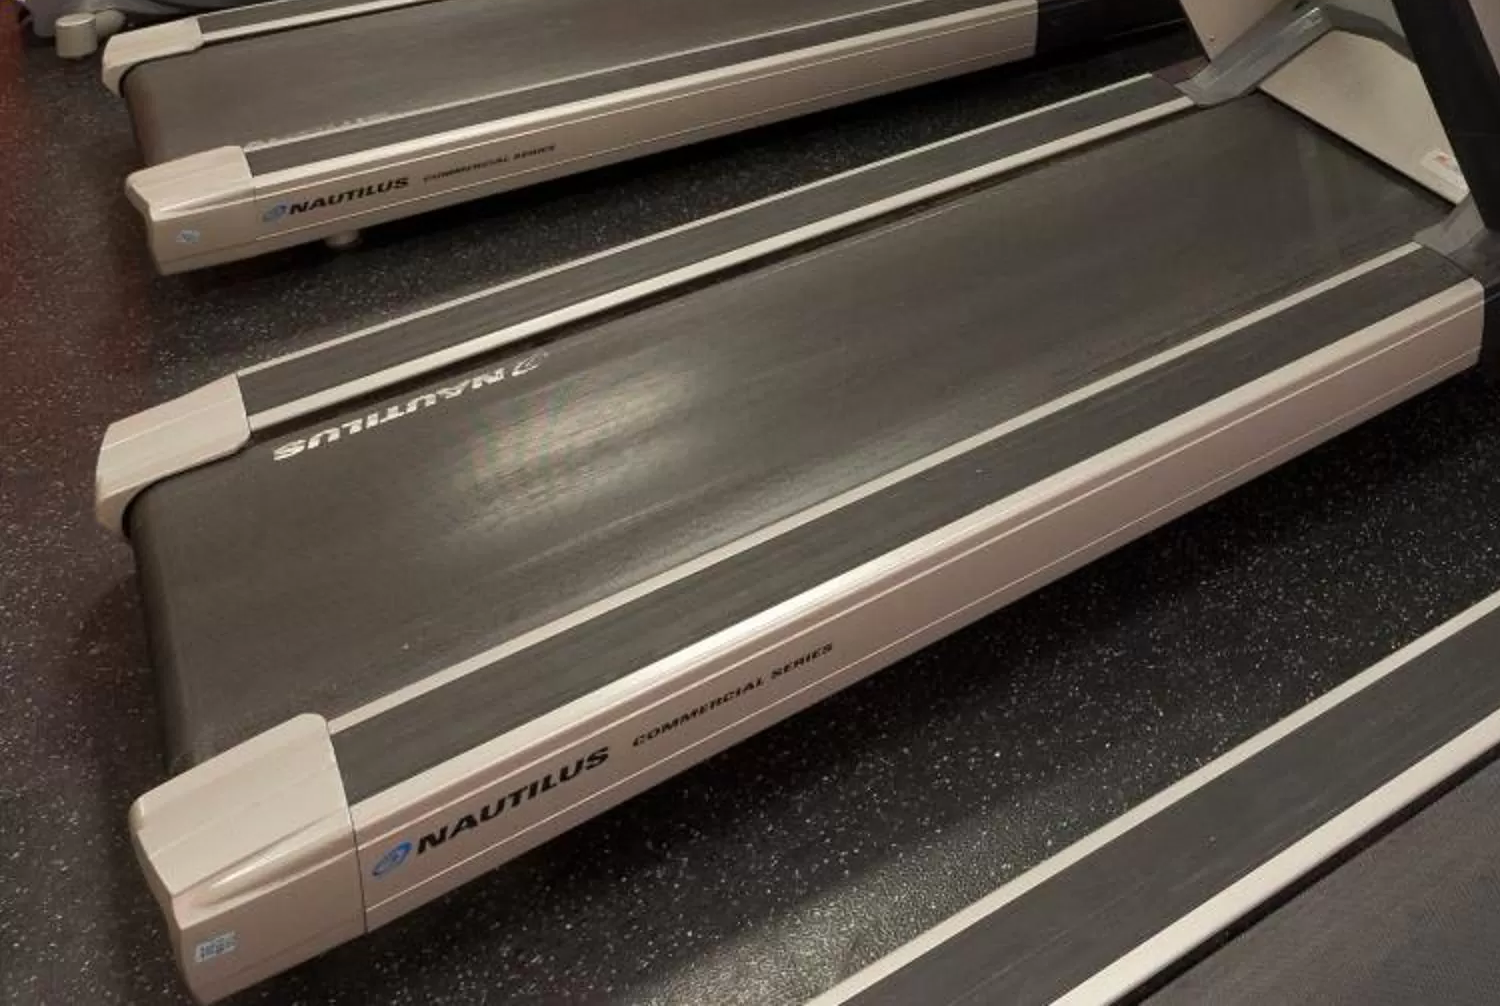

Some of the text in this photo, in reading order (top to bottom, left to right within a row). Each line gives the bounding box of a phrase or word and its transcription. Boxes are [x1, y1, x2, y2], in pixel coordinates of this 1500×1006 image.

[290, 176, 409, 215] NAUTILUS
[273, 367, 505, 461] NAUTILUS
[416, 642, 833, 855] NAUTILUS COMMERCIAL SERIES
